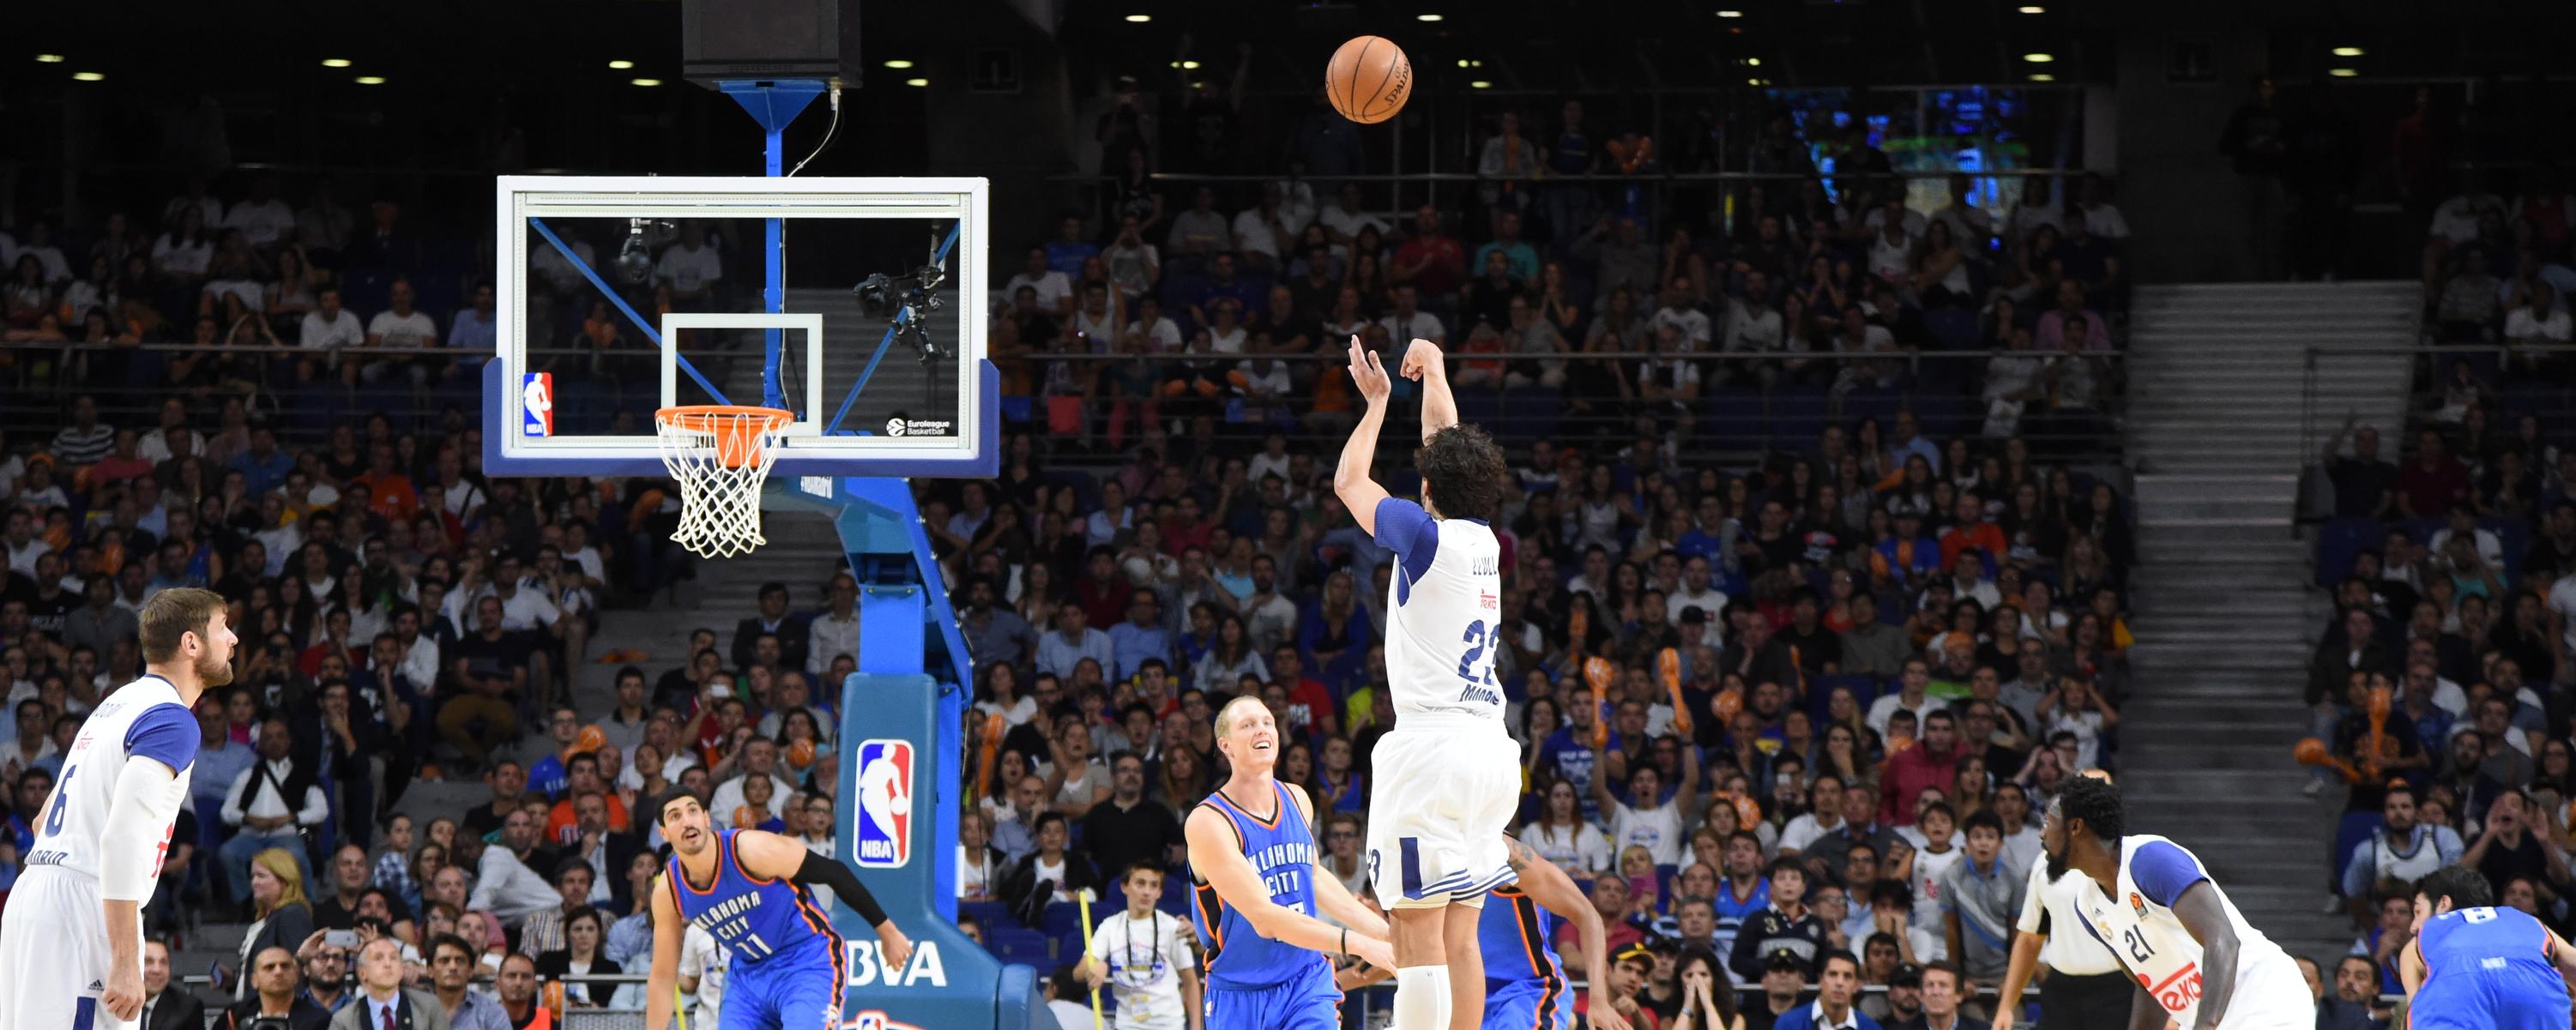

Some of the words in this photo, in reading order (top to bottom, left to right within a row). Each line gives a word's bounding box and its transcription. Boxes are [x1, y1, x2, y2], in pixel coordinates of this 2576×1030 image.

[526, 424, 543, 434] NBA
[907, 420, 950, 429] Euroleague
[1473, 556, 1497, 575] LLULL
[45, 764, 77, 838] 6
[860, 840, 892, 859] NBA
[1248, 843, 1312, 874] KLAHOMA
[1265, 870, 1299, 897] CITY
[693, 891, 761, 931] KLAHOMA
[716, 916, 749, 940] CITY
[735, 933, 773, 959] 11
[2125, 925, 2156, 963] 21
[846, 940, 947, 987] BVA
